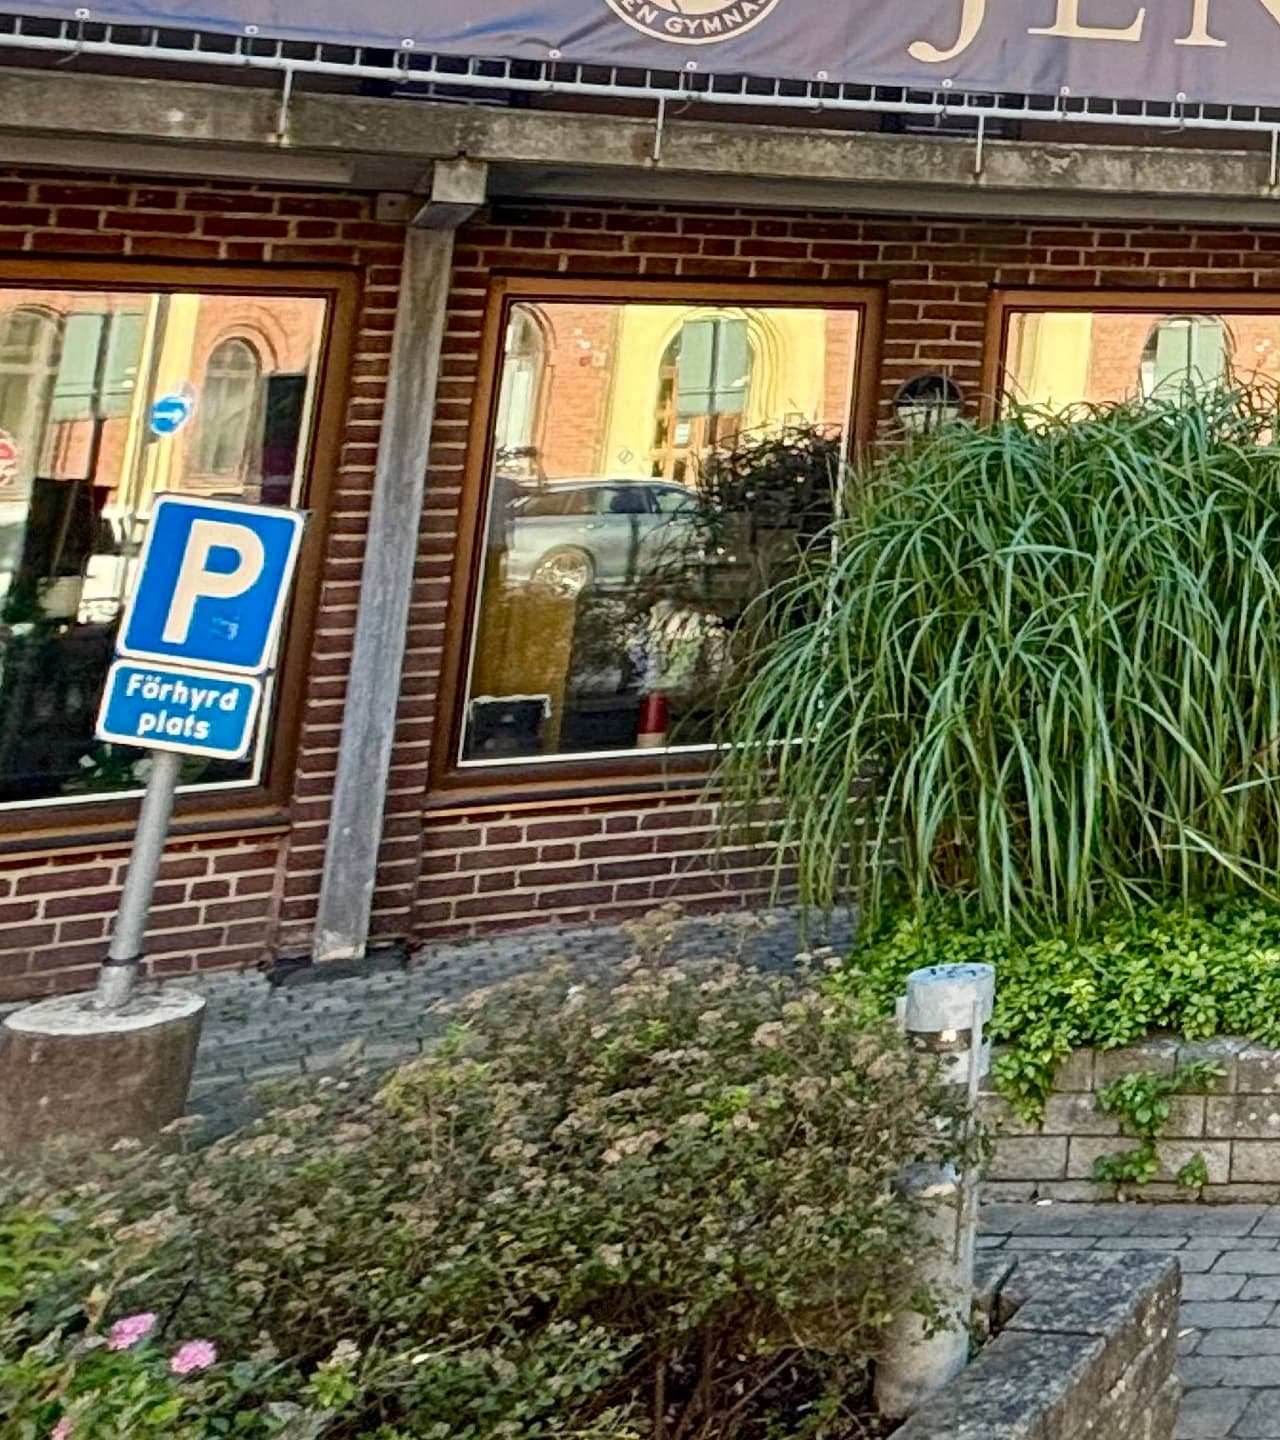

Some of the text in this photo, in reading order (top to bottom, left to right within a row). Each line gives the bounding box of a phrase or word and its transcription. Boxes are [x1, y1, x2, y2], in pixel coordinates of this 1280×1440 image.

[161, 518, 265, 645] P
[125, 672, 240, 712] Förhyrd
[135, 710, 211, 741] plats
